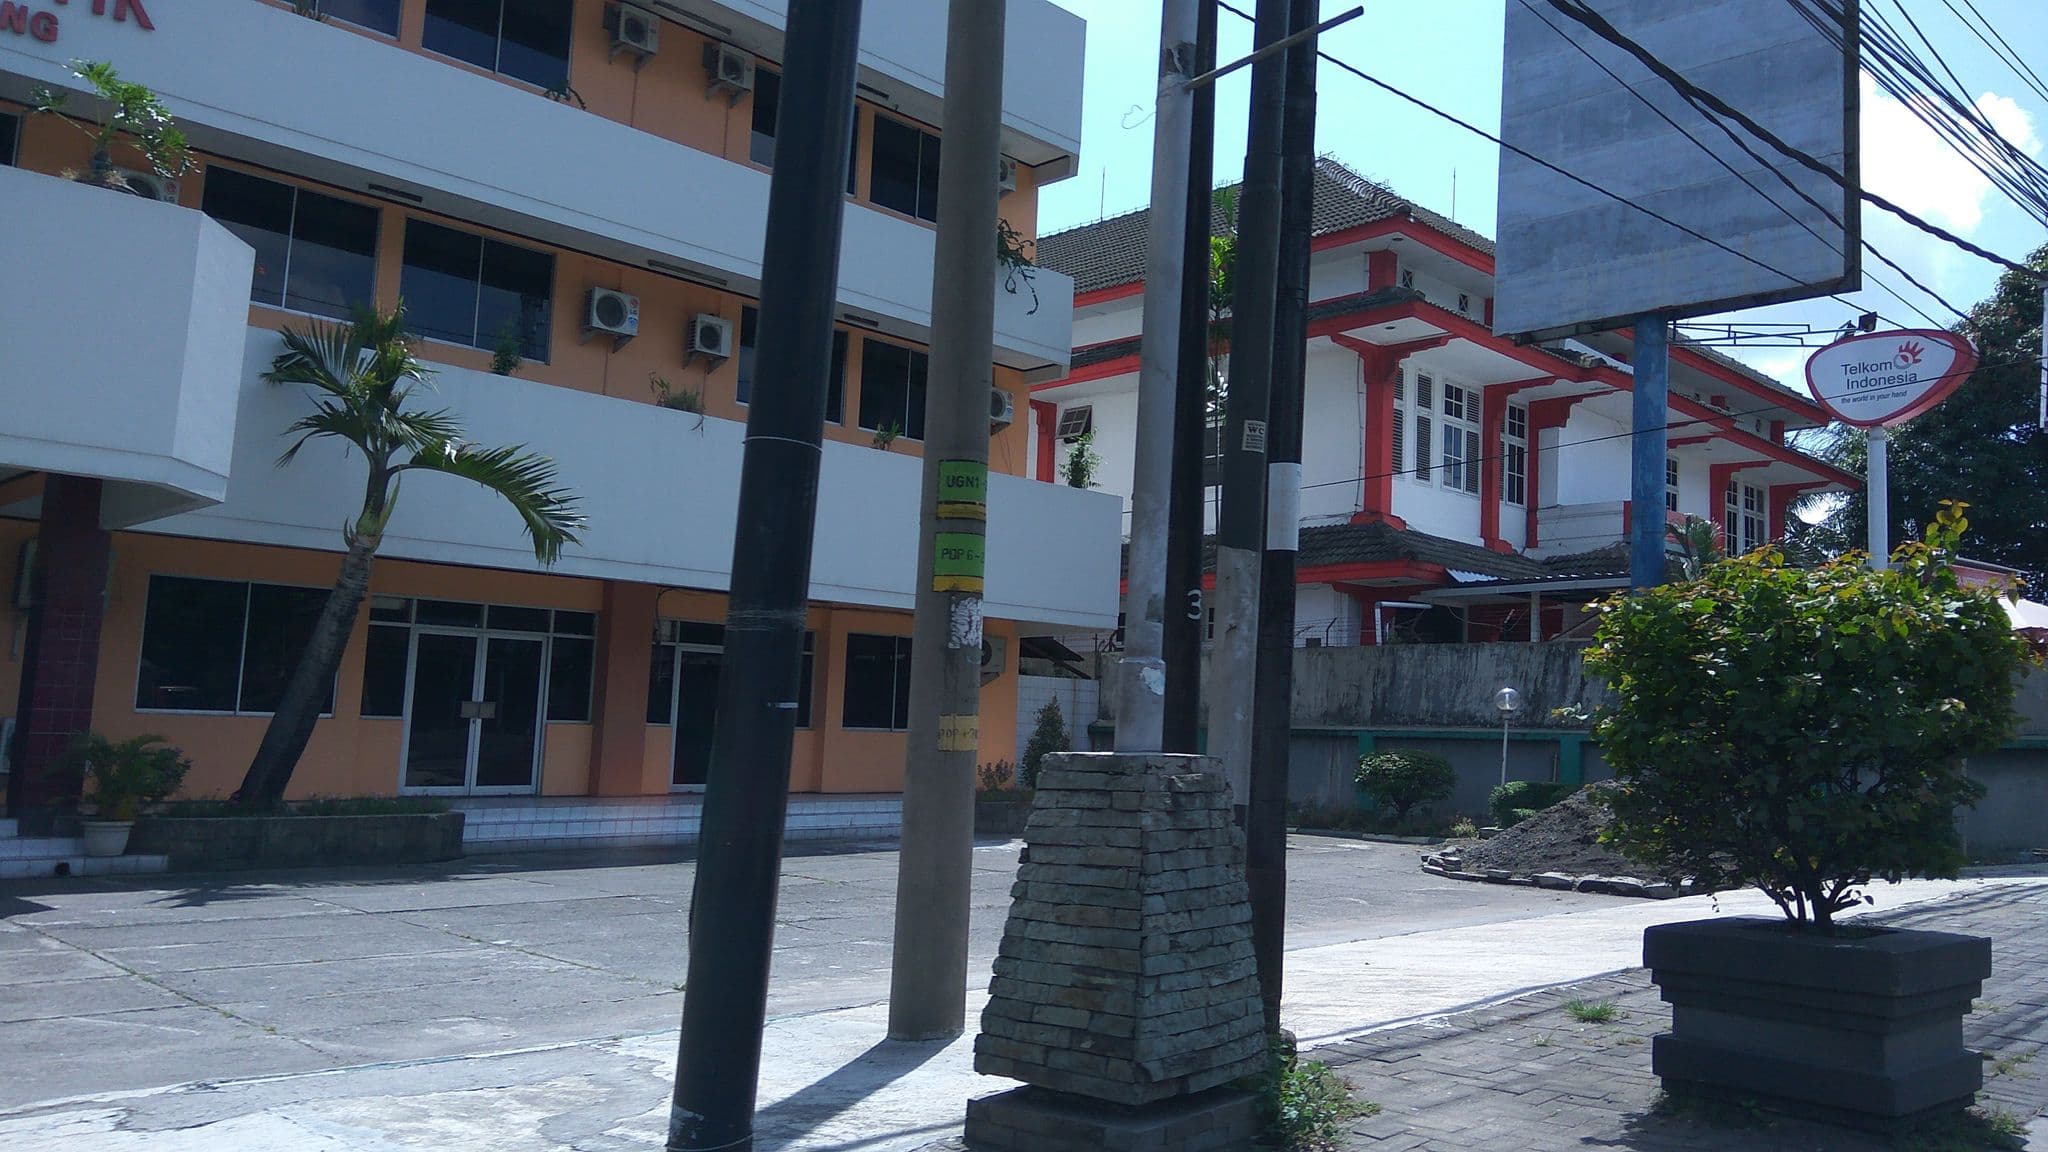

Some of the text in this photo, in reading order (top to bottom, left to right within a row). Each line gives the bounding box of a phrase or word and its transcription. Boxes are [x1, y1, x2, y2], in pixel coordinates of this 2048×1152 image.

[1841, 361, 1893, 376] Telkom
[1846, 371, 1918, 390] Indonesia
[1852, 393, 1869, 402] world
[1877, 391, 1891, 401] your
[1248, 426, 1265, 434] WC
[1188, 589, 1202, 619] 3
